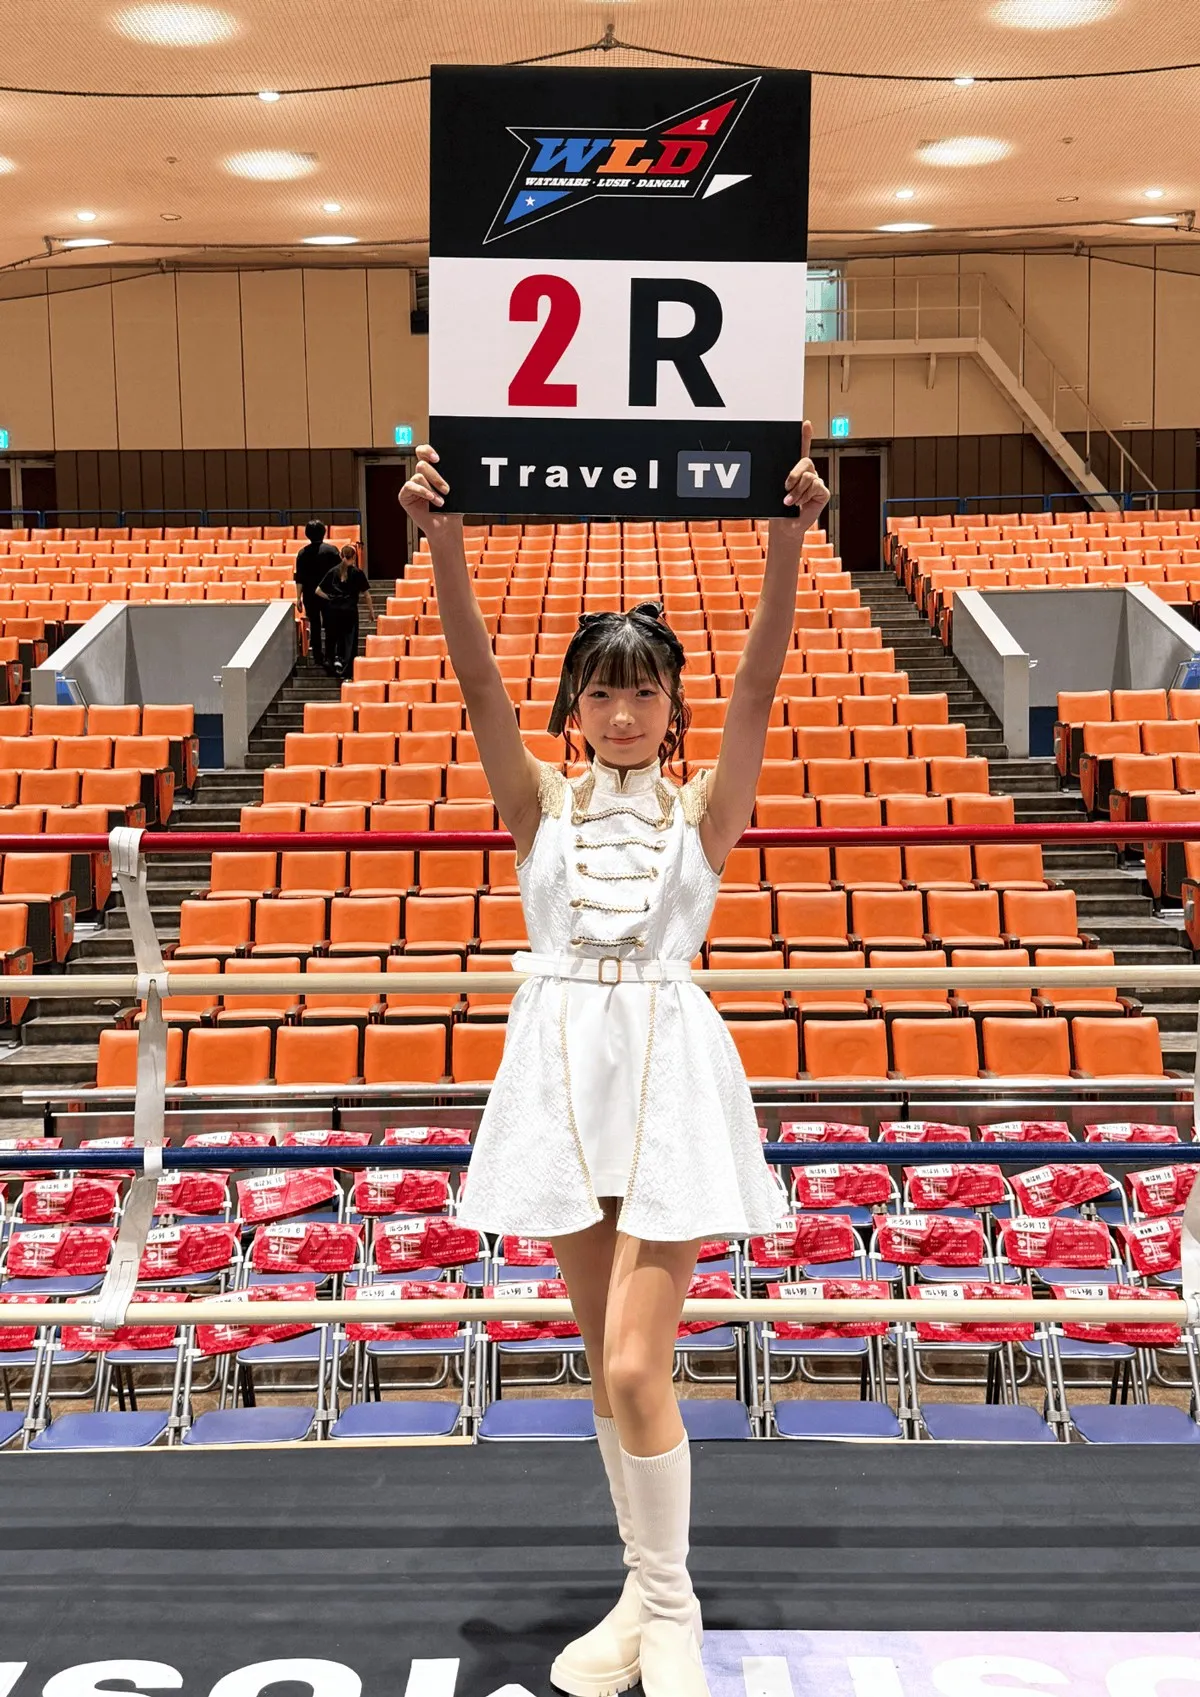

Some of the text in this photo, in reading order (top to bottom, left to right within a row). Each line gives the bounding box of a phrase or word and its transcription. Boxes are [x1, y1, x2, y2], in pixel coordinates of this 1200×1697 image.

[695, 119, 707, 131] 1
[530, 137, 709, 174] WLD
[525, 177, 691, 188] WATANABE LUSH DANGAN
[508, 273, 727, 408] 2 R
[481, 456, 741, 490] Travel TV
